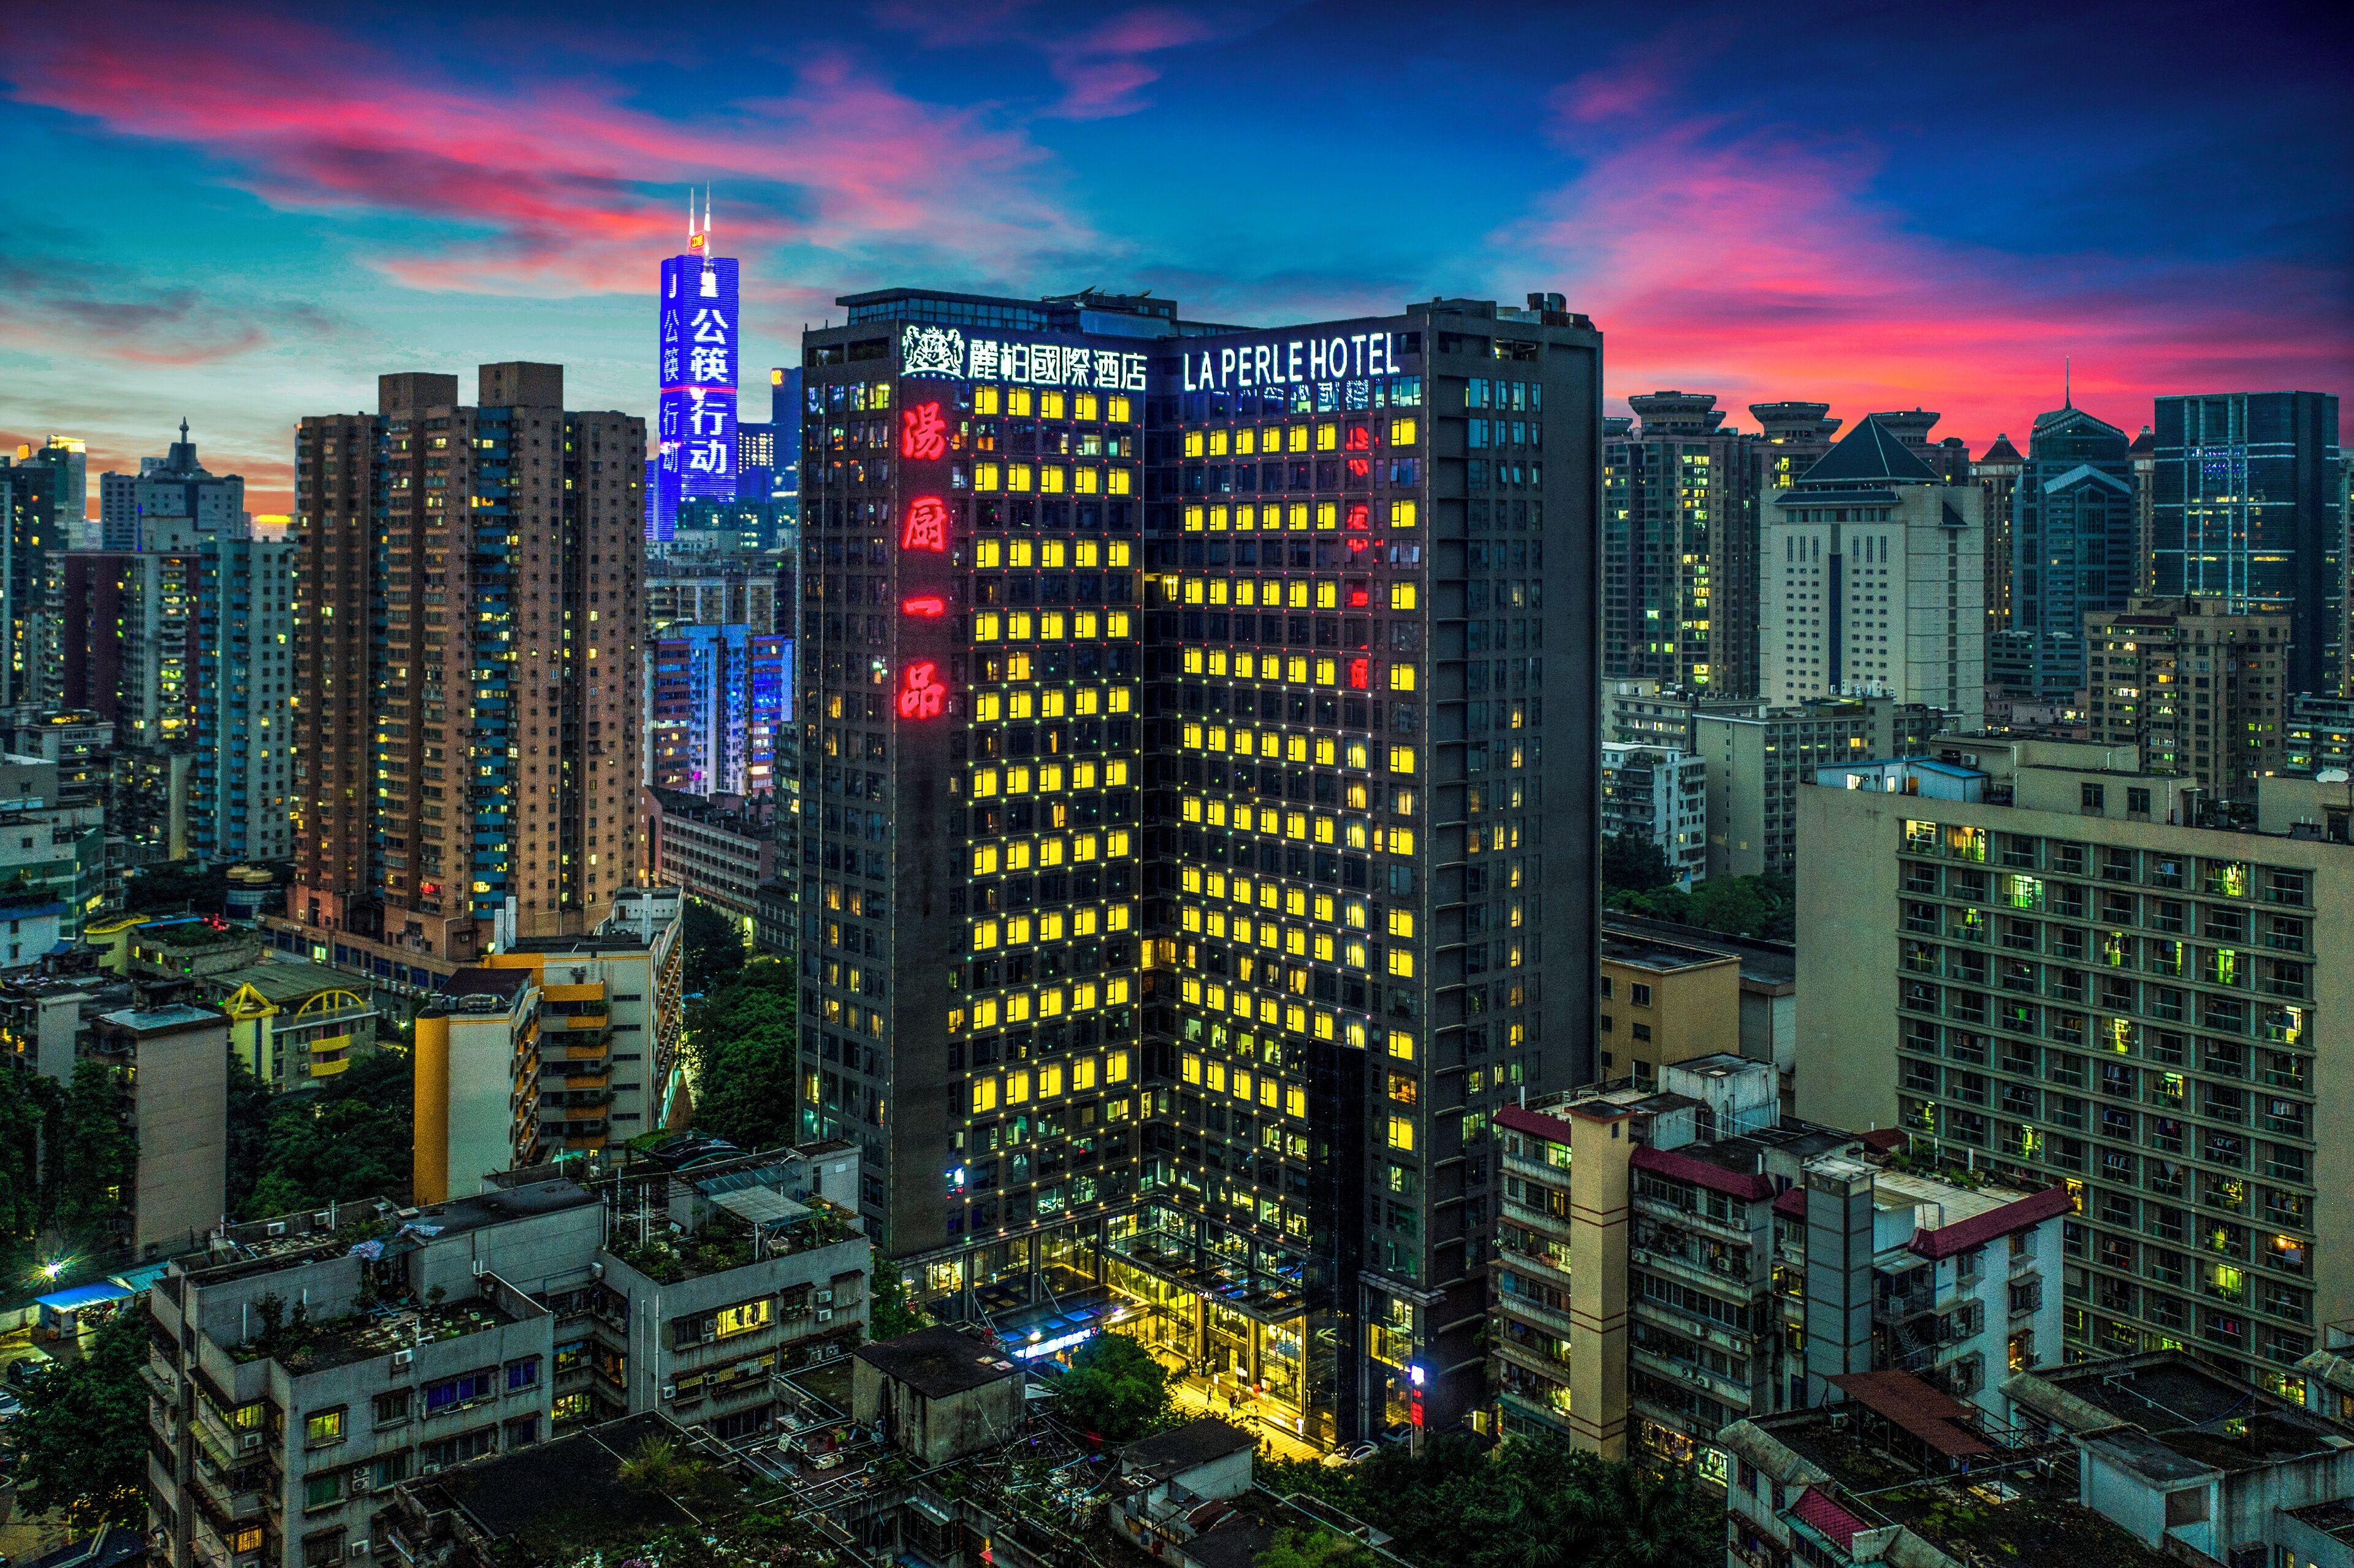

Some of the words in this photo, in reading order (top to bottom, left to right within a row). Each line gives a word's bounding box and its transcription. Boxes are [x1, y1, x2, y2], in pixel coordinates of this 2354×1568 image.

[663, 310, 679, 473] 公筷行动
[690, 308, 729, 474] 公筷行动
[968, 339, 1148, 391] 麗柏國際酒店
[1184, 351, 1214, 392] LA
[1221, 341, 1303, 388] PERLE
[1310, 332, 1400, 380] HOTEL
